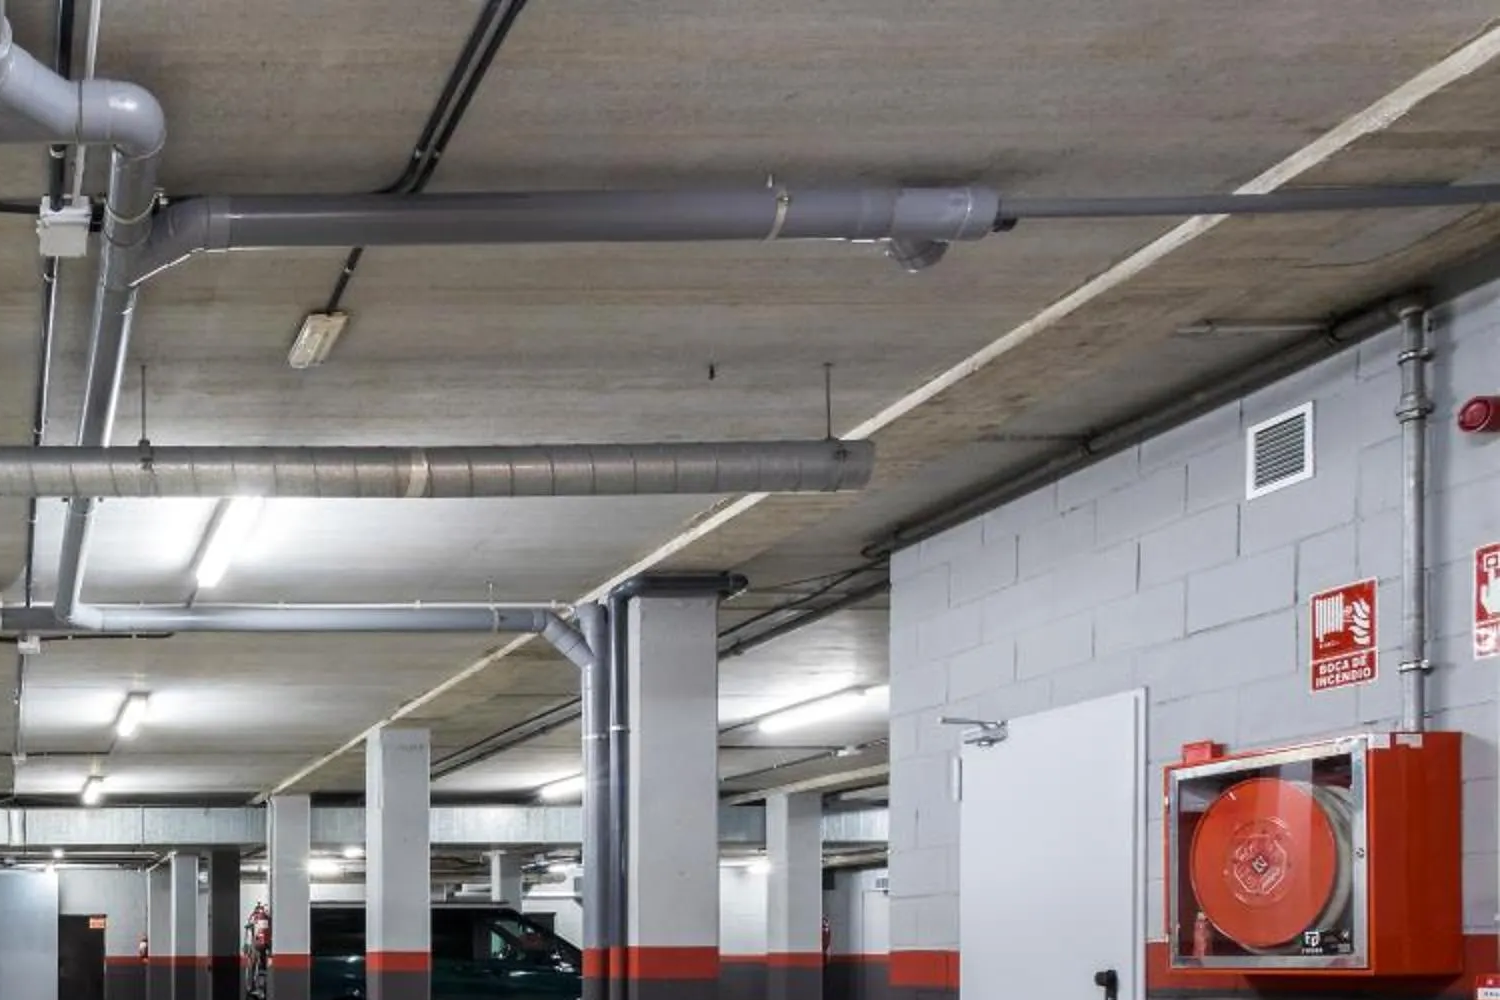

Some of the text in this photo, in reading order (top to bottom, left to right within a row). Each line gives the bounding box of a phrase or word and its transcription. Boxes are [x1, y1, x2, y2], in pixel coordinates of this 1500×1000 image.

[1319, 655, 1368, 675] BOCA DE
[1315, 667, 1371, 688] INCENDIO
